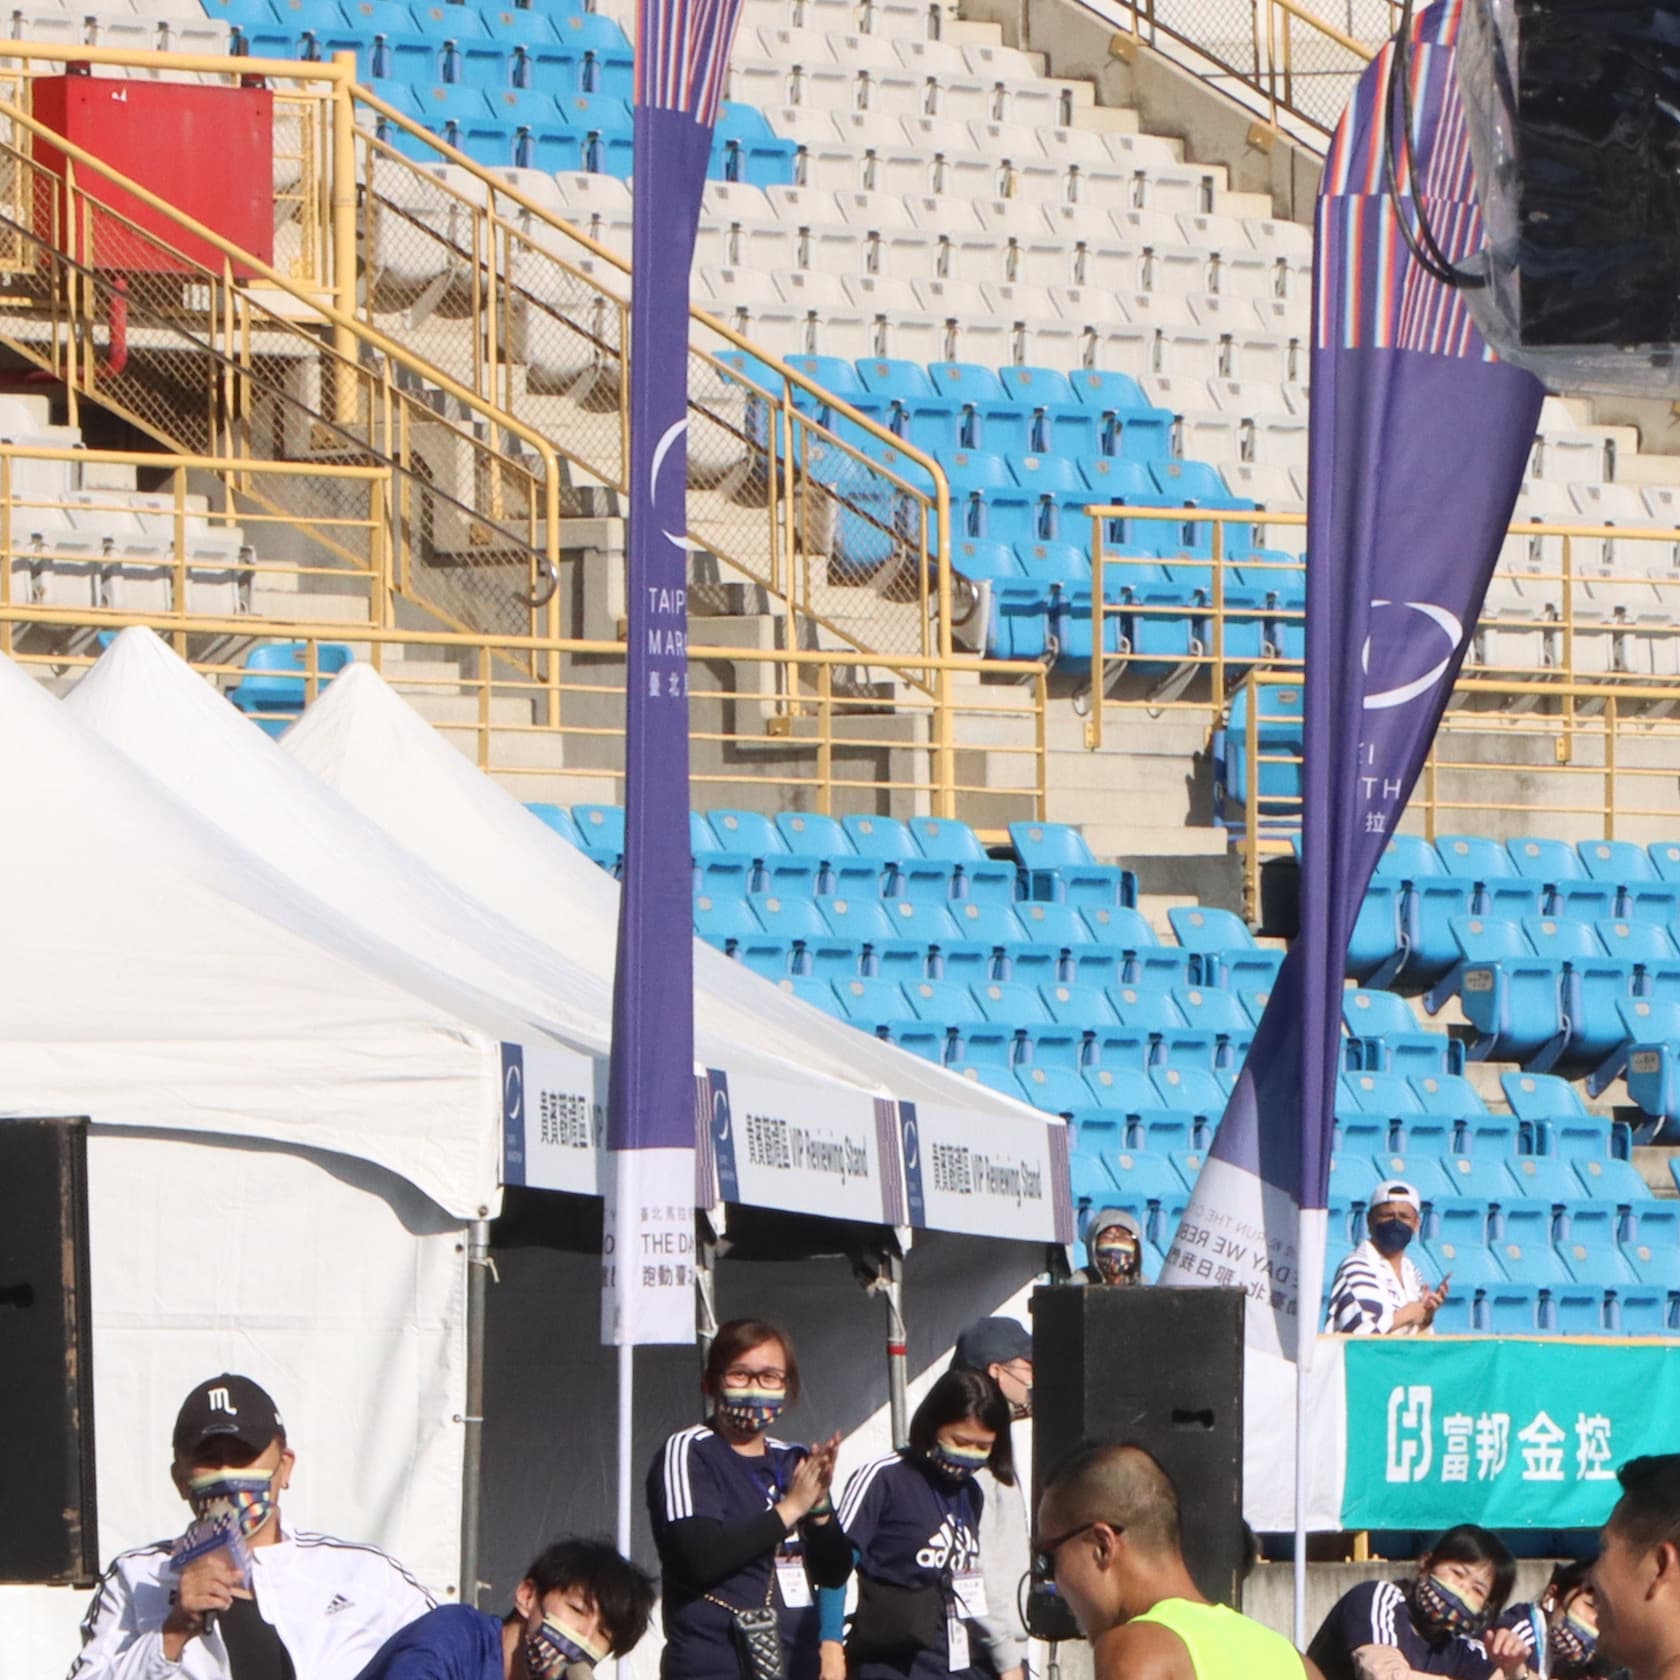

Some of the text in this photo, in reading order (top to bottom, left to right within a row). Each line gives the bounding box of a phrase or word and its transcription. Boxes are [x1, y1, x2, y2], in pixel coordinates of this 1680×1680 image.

[648, 588, 687, 617] TAIP
[648, 671, 688, 698] 臺北
[640, 1231, 674, 1255] THE
[1440, 1410, 1615, 1484] 富邦金控
